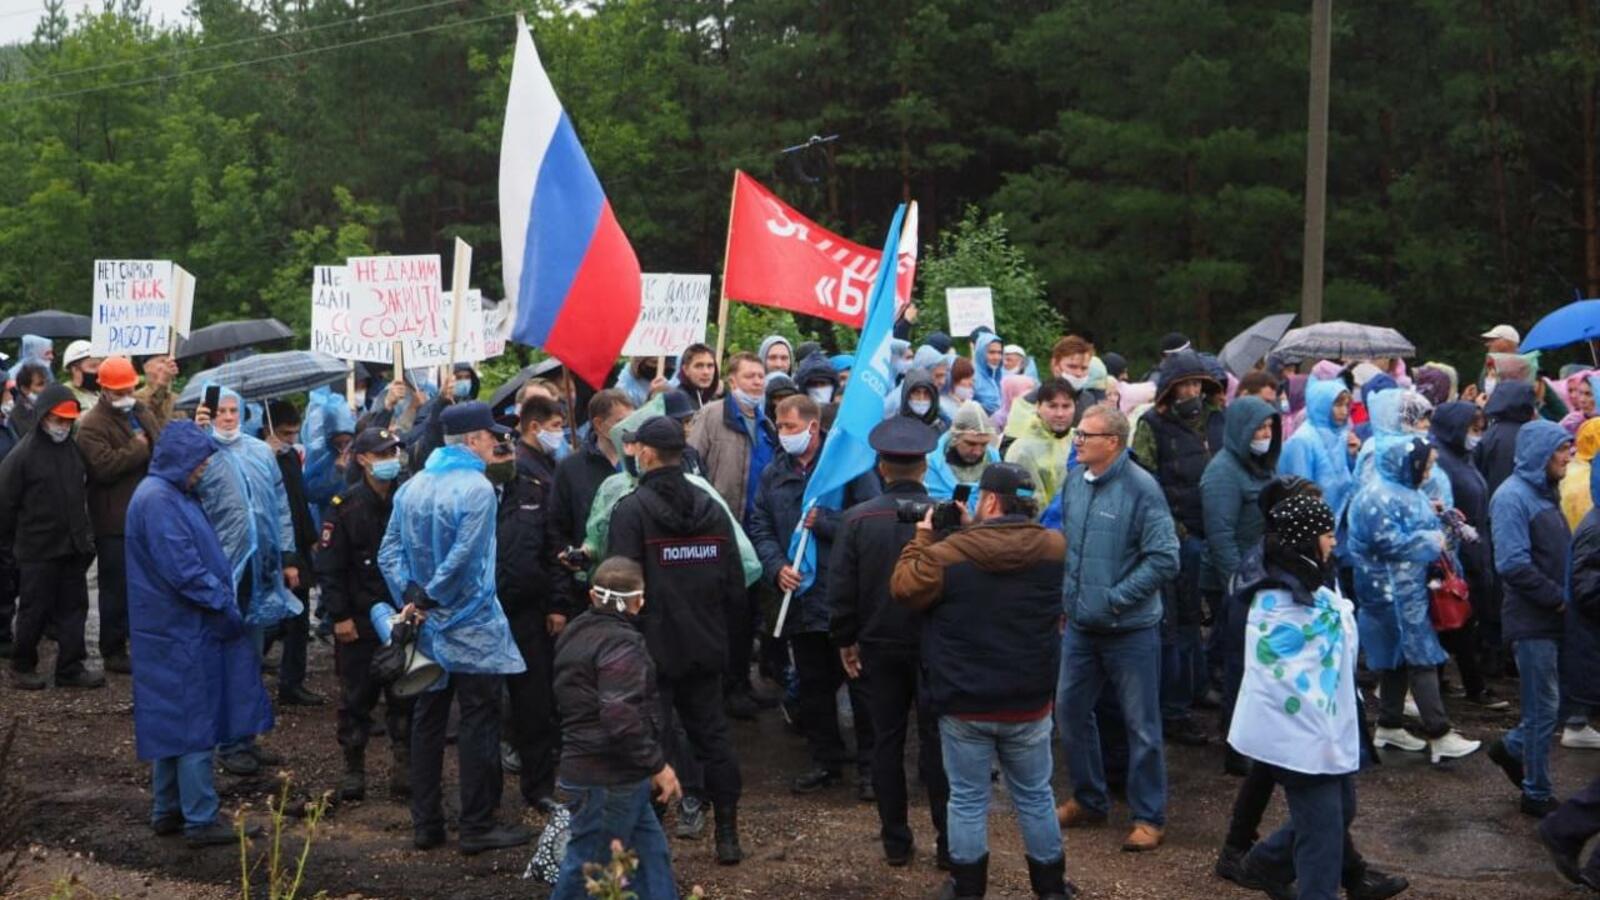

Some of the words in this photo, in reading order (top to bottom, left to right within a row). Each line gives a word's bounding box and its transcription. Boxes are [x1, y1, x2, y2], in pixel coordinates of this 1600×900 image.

[97, 262, 115, 280] НЕТ
[355, 260, 379, 282] НЕ
[384, 259, 438, 282] ДАДИМ
[105, 282, 126, 299] НЕТ
[99, 304, 129, 324] НАМ
[359, 313, 438, 338] СОДУ!
[108, 326, 166, 351] РАБОТА
[662, 545, 717, 560] ПОЛИЦИЯ
